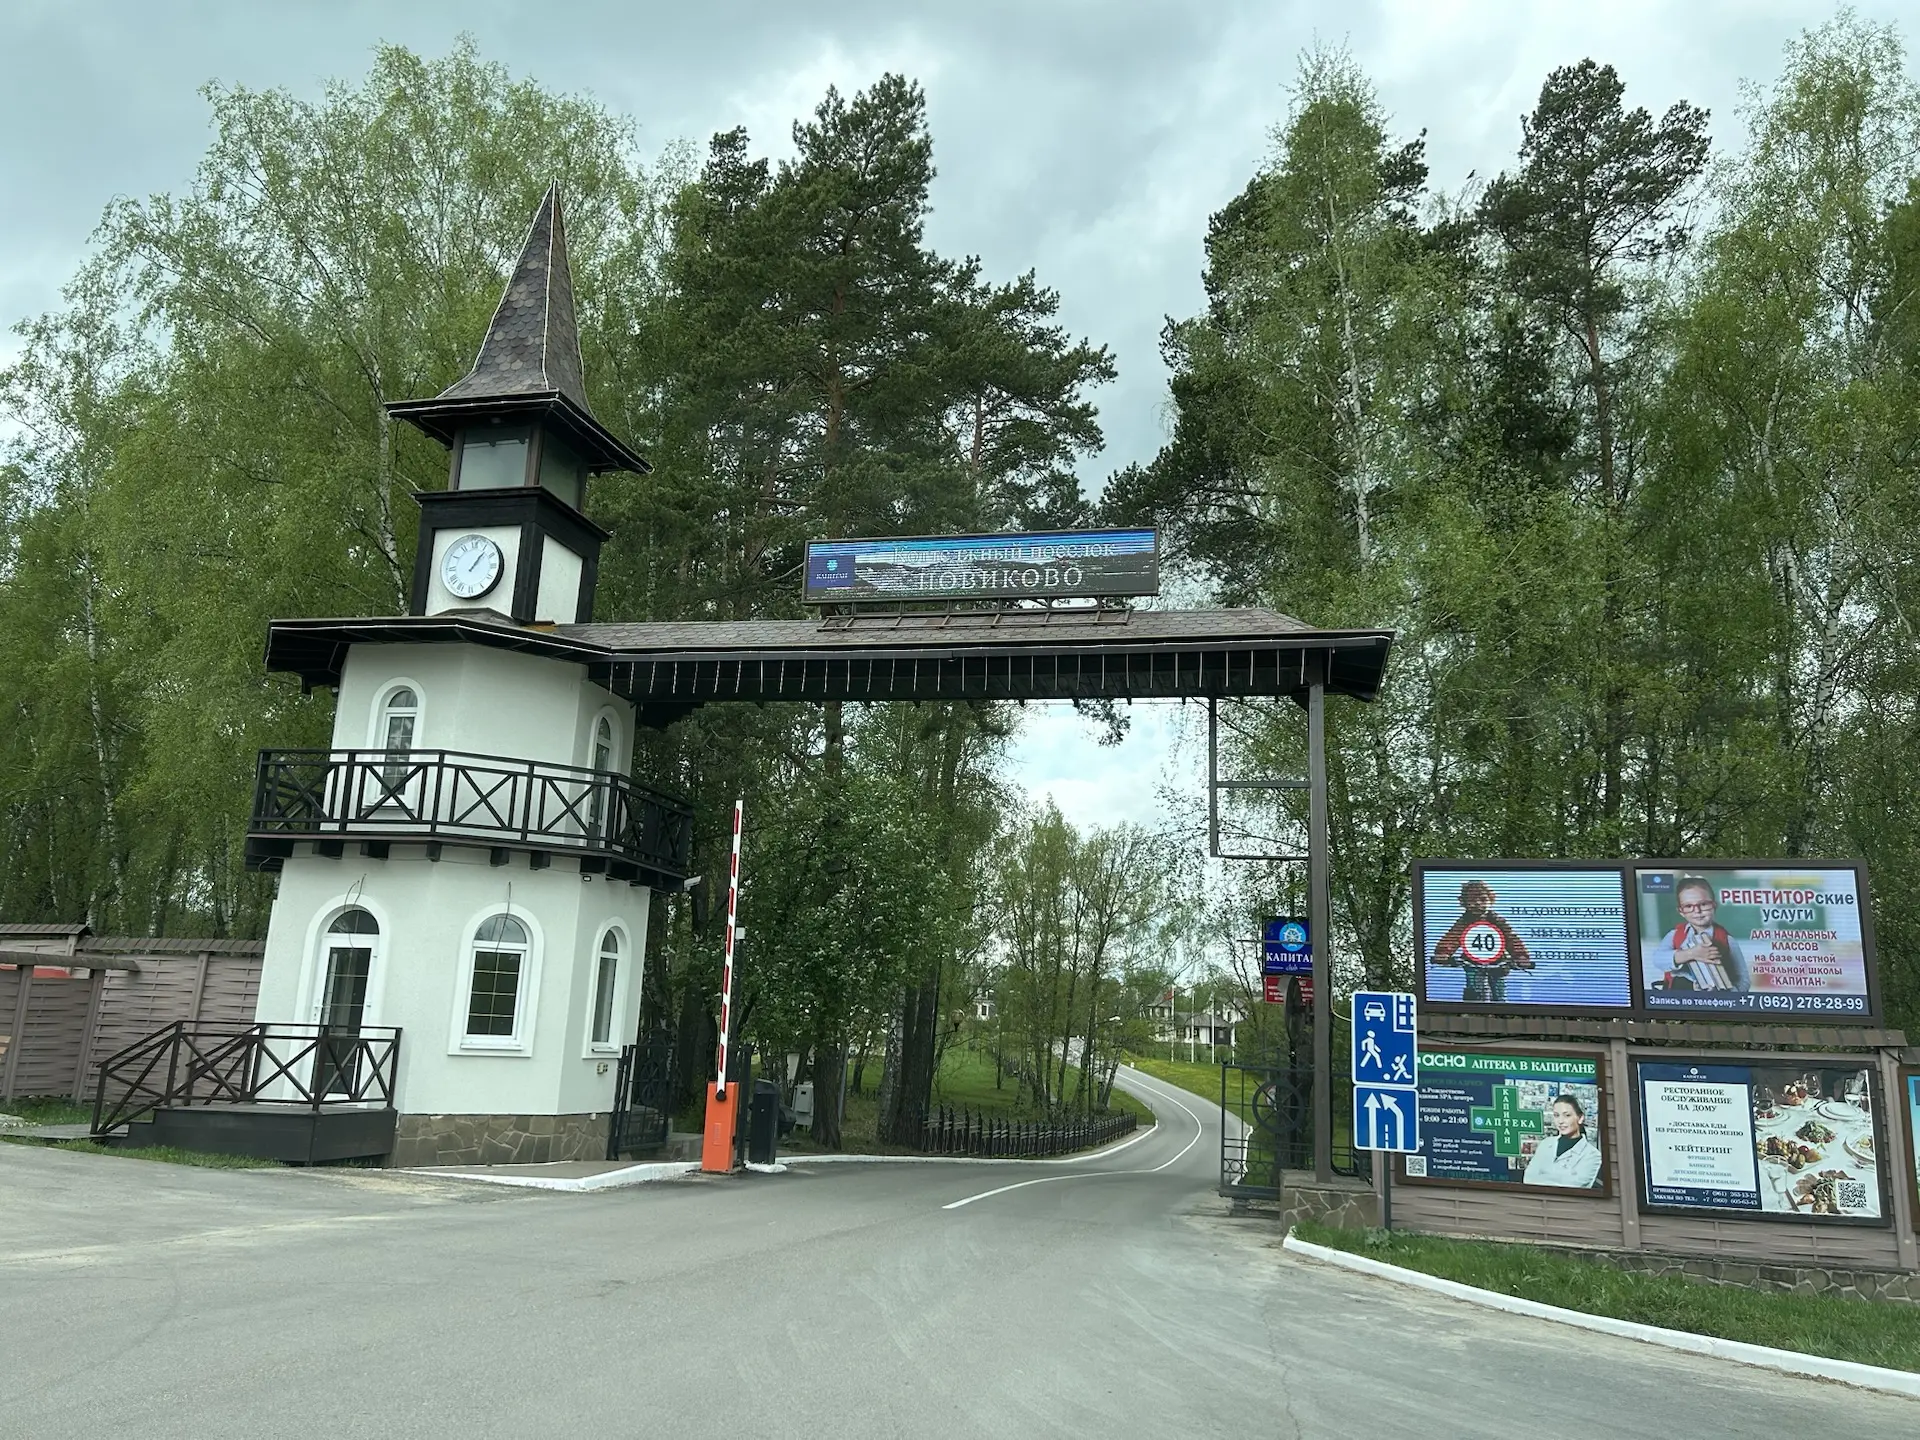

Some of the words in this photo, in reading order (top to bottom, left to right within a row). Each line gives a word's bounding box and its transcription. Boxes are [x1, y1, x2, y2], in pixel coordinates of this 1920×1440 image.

[917, 567, 1083, 591] НОВИКОВО
[1721, 890, 1854, 905] РЕПЕТИТОРские
[1762, 909, 1814, 922] услуги
[1752, 930, 1771, 940] ДЛЯ
[1774, 930, 1838, 940] НАЧАЛЬНЫХ
[1471, 934, 1496, 951] 40
[1771, 941, 1819, 951] КЛАССОВ
[1769, 953, 1793, 962] базе
[1795, 954, 1836, 963] частной
[1753, 965, 1805, 974] начальной
[1808, 967, 1843, 975] школы
[1650, 996, 1680, 1005] Запись
[1682, 998, 1692, 1006] по
[1694, 998, 1737, 1008] телефону:
[1739, 996, 1755, 1007] +7
[1759, 996, 1794, 1010] (962)
[1797, 997, 1864, 1010] 278-28-99
[1471, 1060, 1517, 1071] АПТЕКА
[1520, 1061, 1528, 1071] В
[1531, 1061, 1595, 1074] КАПИТАНЕ
[1663, 1087, 1725, 1096] РЕСТОРАННОЕ
[1660, 1095, 1733, 1104] ОБСЛУЖИВАНИЕ
[1448, 1116, 1468, 1124] 21:00
[1485, 1118, 1535, 1128] АПТЕКА
[1674, 1144, 1733, 1154] КЕЙТЕРИНГ
